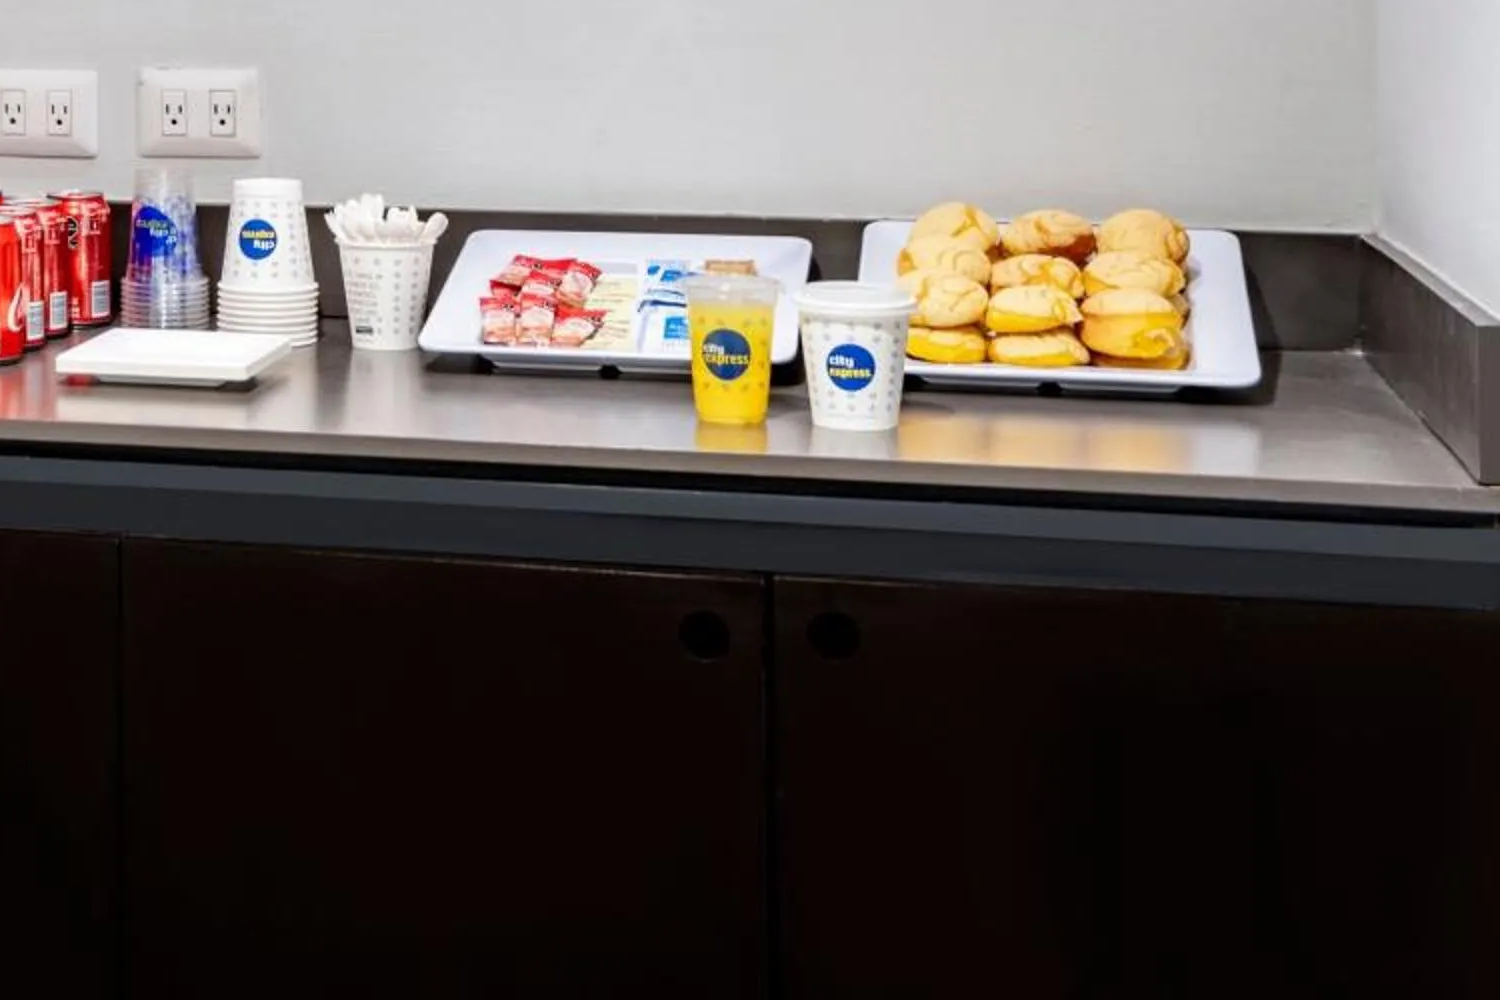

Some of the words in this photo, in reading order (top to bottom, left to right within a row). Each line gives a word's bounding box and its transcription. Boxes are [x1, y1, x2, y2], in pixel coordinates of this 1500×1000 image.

[253, 239, 275, 250] city
[702, 342, 725, 355] city
[704, 353, 749, 366] express
[829, 354, 855, 368] city
[829, 368, 872, 379] express
